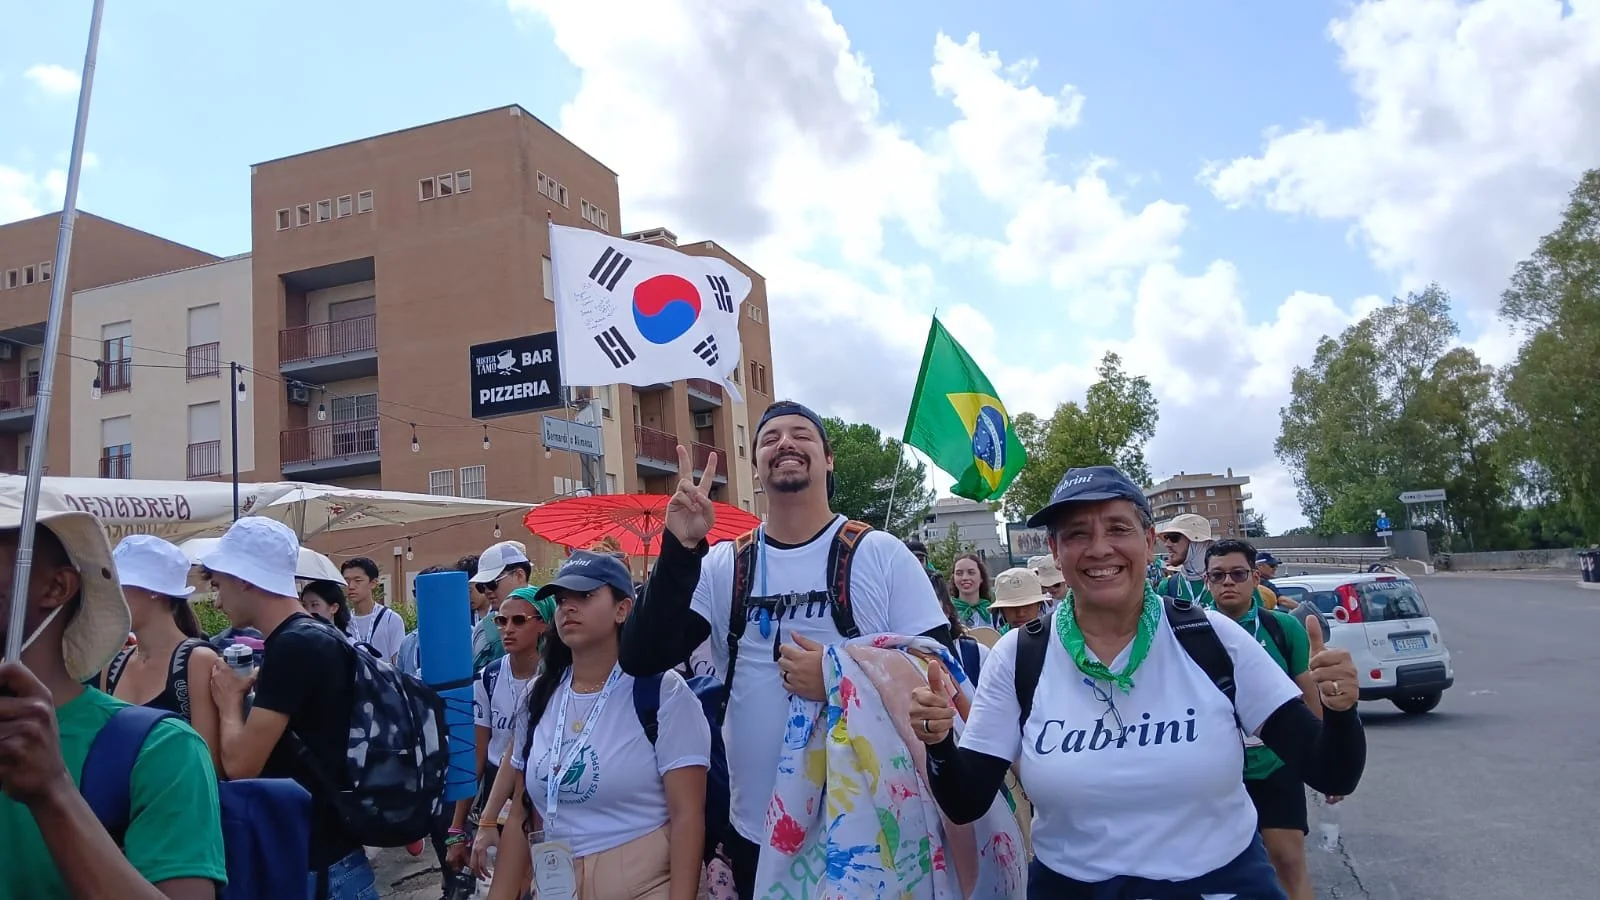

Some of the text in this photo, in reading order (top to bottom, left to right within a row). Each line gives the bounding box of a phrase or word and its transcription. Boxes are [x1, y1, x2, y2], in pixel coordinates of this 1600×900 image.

[521, 348, 552, 366] BAR
[479, 380, 551, 404] PIZZERIA
[546, 429, 573, 445] Bernardio
[1035, 708, 1199, 755] Cabrini
